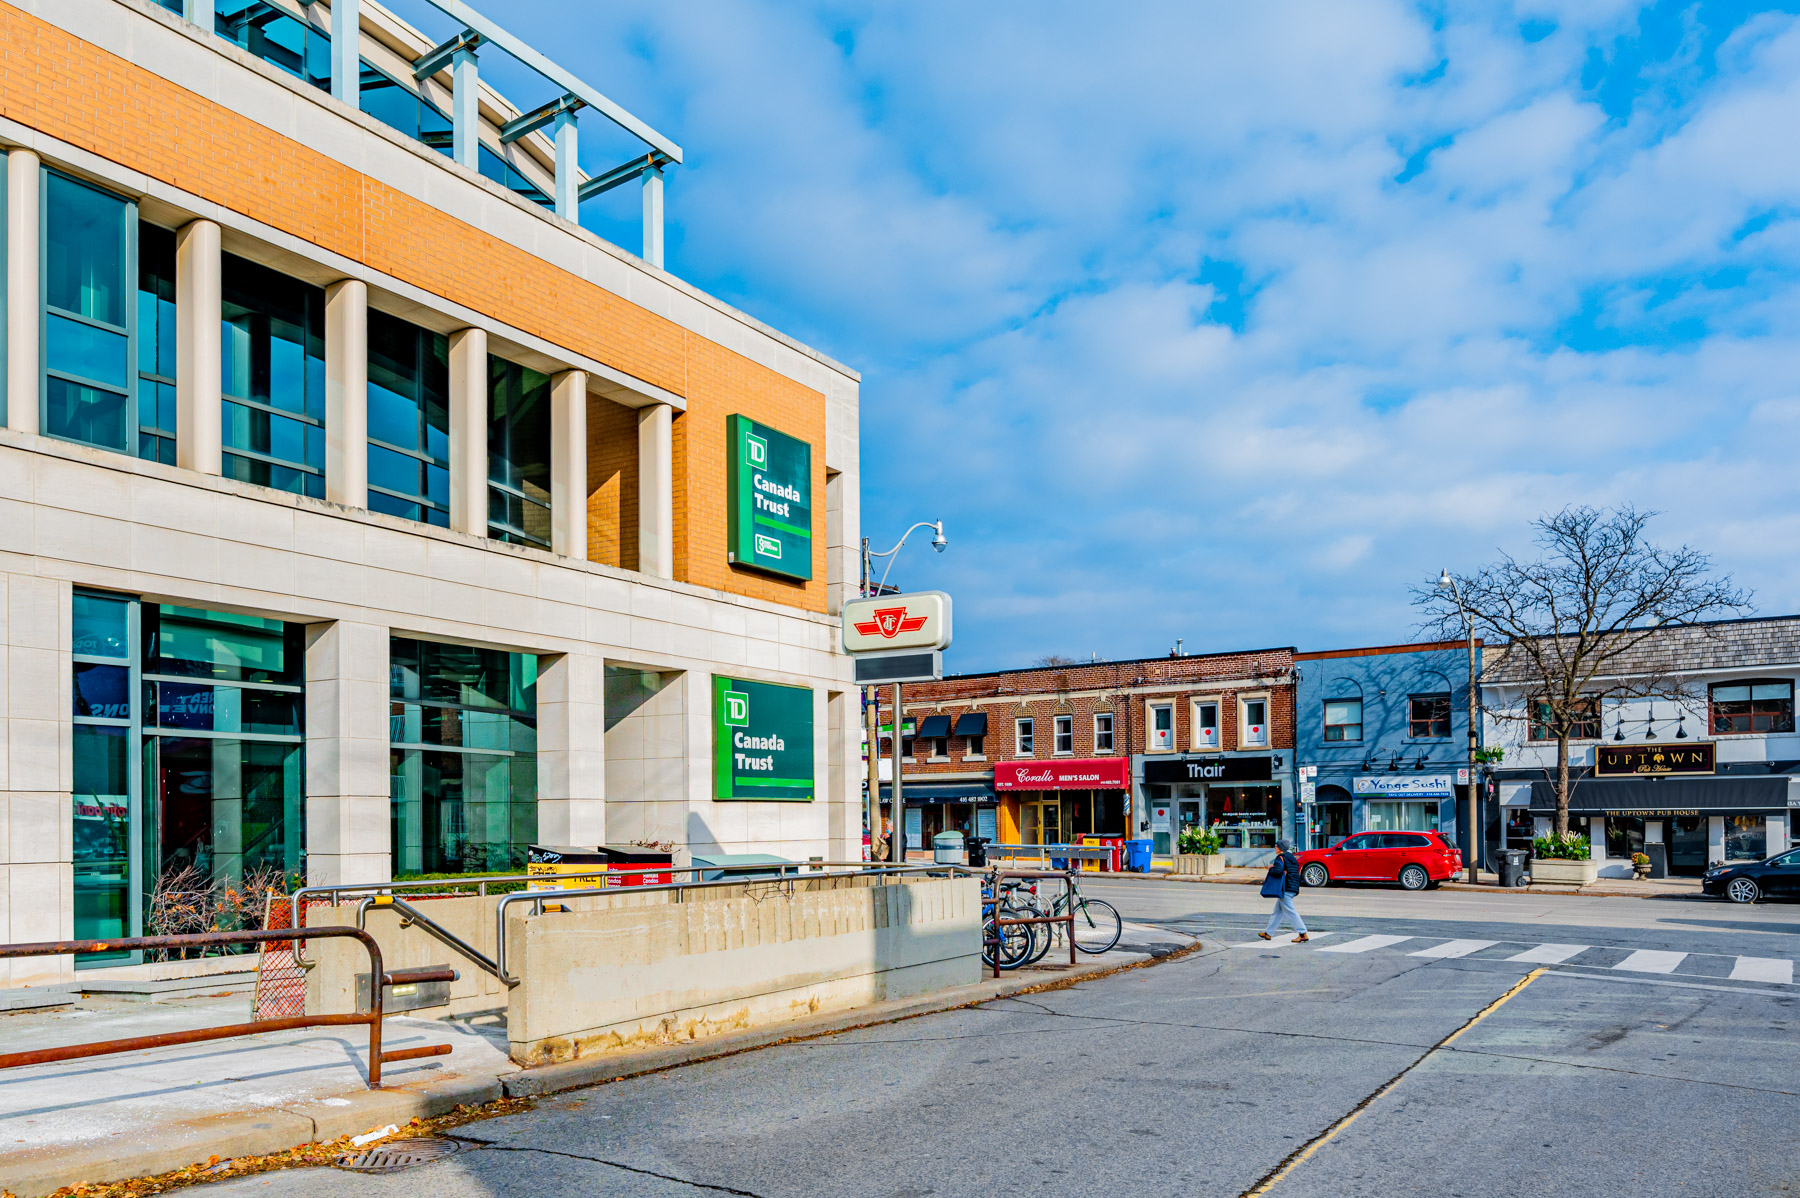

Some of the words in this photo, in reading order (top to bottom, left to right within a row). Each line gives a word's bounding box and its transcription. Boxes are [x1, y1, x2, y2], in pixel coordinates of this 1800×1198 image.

[748, 439, 765, 464] TD
[753, 474, 800, 503] Canada
[754, 493, 790, 518] Trust
[727, 698, 746, 719] TD
[734, 732, 785, 751] Canada
[735, 753, 774, 771] Trust
[1607, 752, 1703, 765] UPTOWN
[1015, 768, 1054, 783] Corallo
[1186, 763, 1225, 778] Thair
[1651, 764, 1672, 772] House
[1370, 780, 1409, 791] Yonge
[1412, 779, 1446, 788] Sushi
